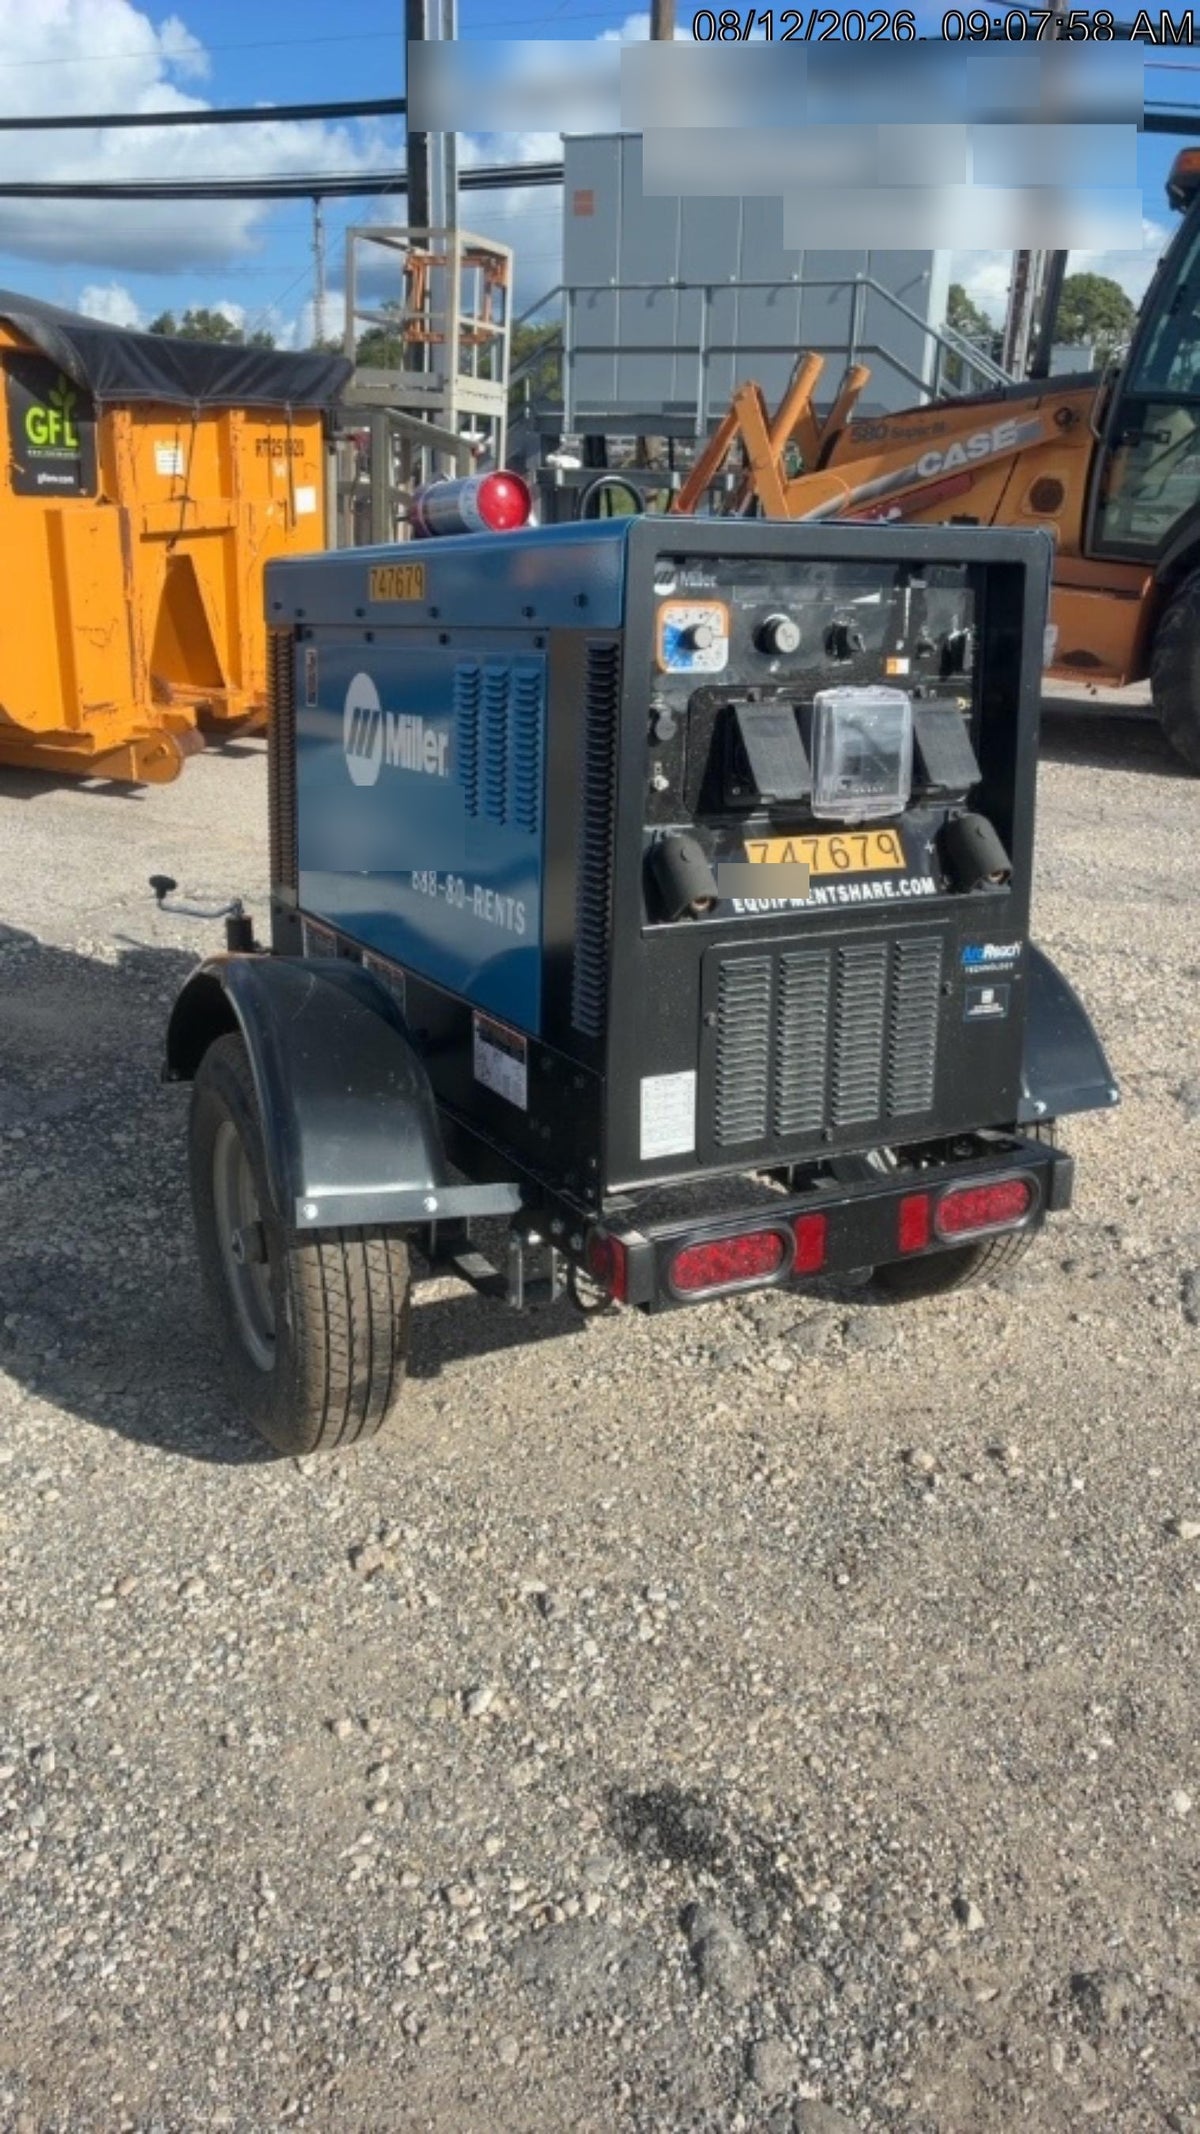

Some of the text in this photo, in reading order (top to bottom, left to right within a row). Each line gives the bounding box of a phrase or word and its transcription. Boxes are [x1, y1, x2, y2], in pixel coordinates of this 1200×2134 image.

[26, 406, 79, 447] GFL
[917, 417, 1018, 477] CASE
[372, 566, 423, 598] 747679
[680, 571, 717, 587] Miller
[386, 711, 449, 777] Miller
[411, 870, 525, 935] 888-80-RENTS
